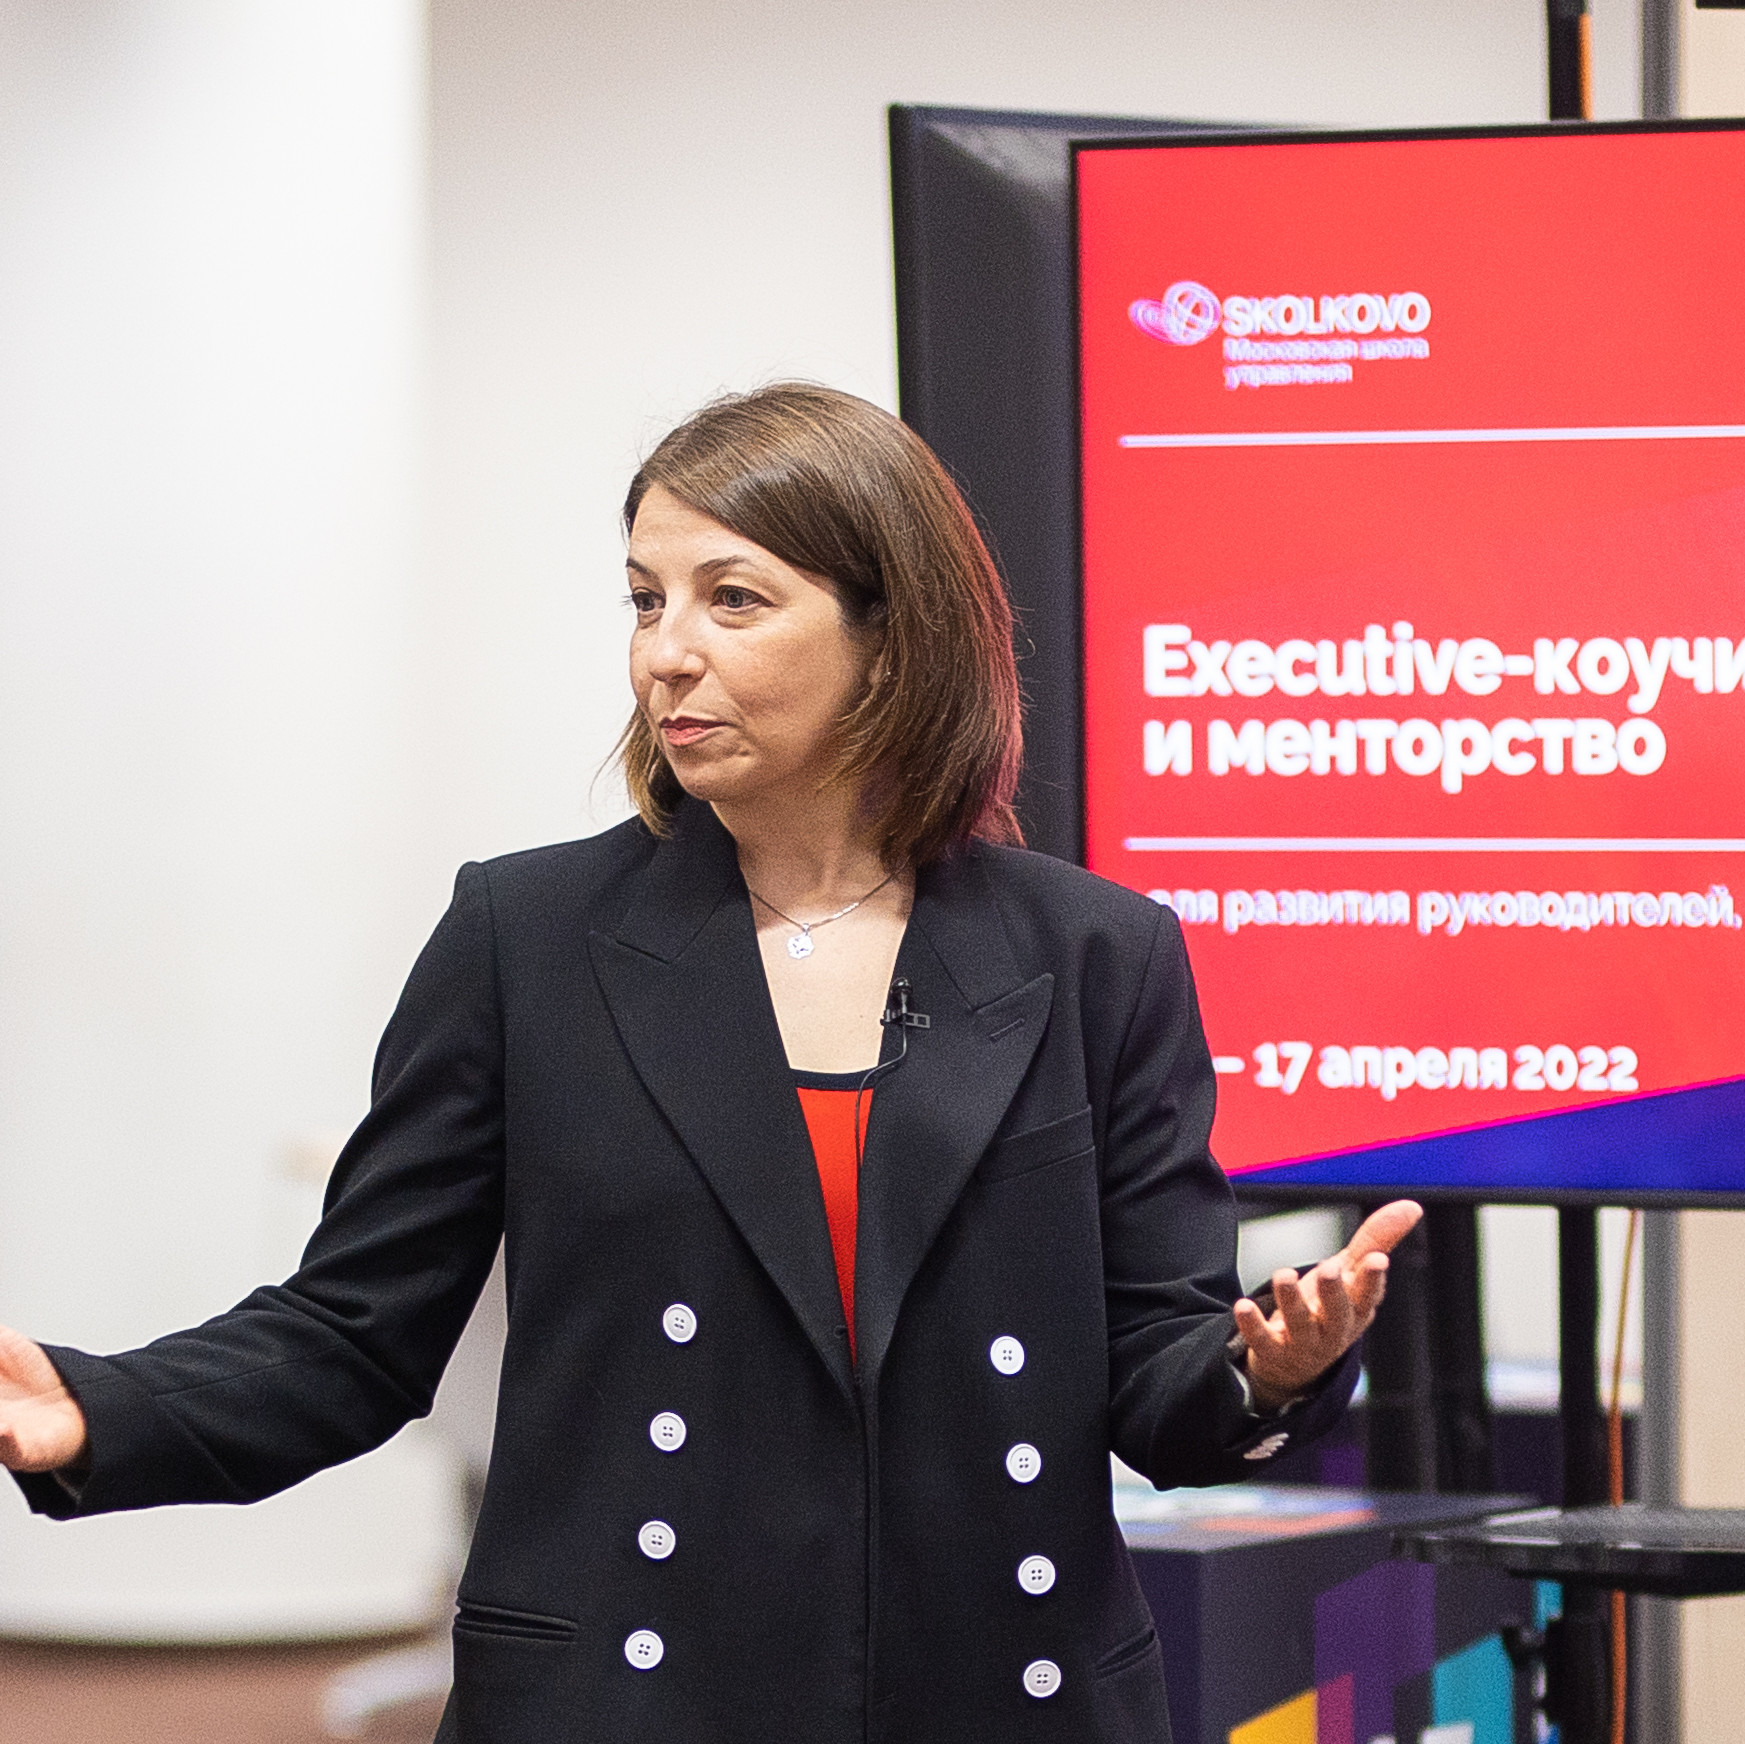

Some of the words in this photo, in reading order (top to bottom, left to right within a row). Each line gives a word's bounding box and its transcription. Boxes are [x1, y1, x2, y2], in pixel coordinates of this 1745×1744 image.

[1222, 292, 1431, 336] SKOLKOVO
[1143, 719, 1193, 776] и
[1208, 717, 1667, 794] менторство
[1223, 890, 1410, 934] развития
[1417, 885, 1743, 937] руководителей,
[1253, 1041, 1313, 1095] 17
[1317, 1046, 1508, 1101] апреля
[1512, 1044, 1639, 1092] 2022
